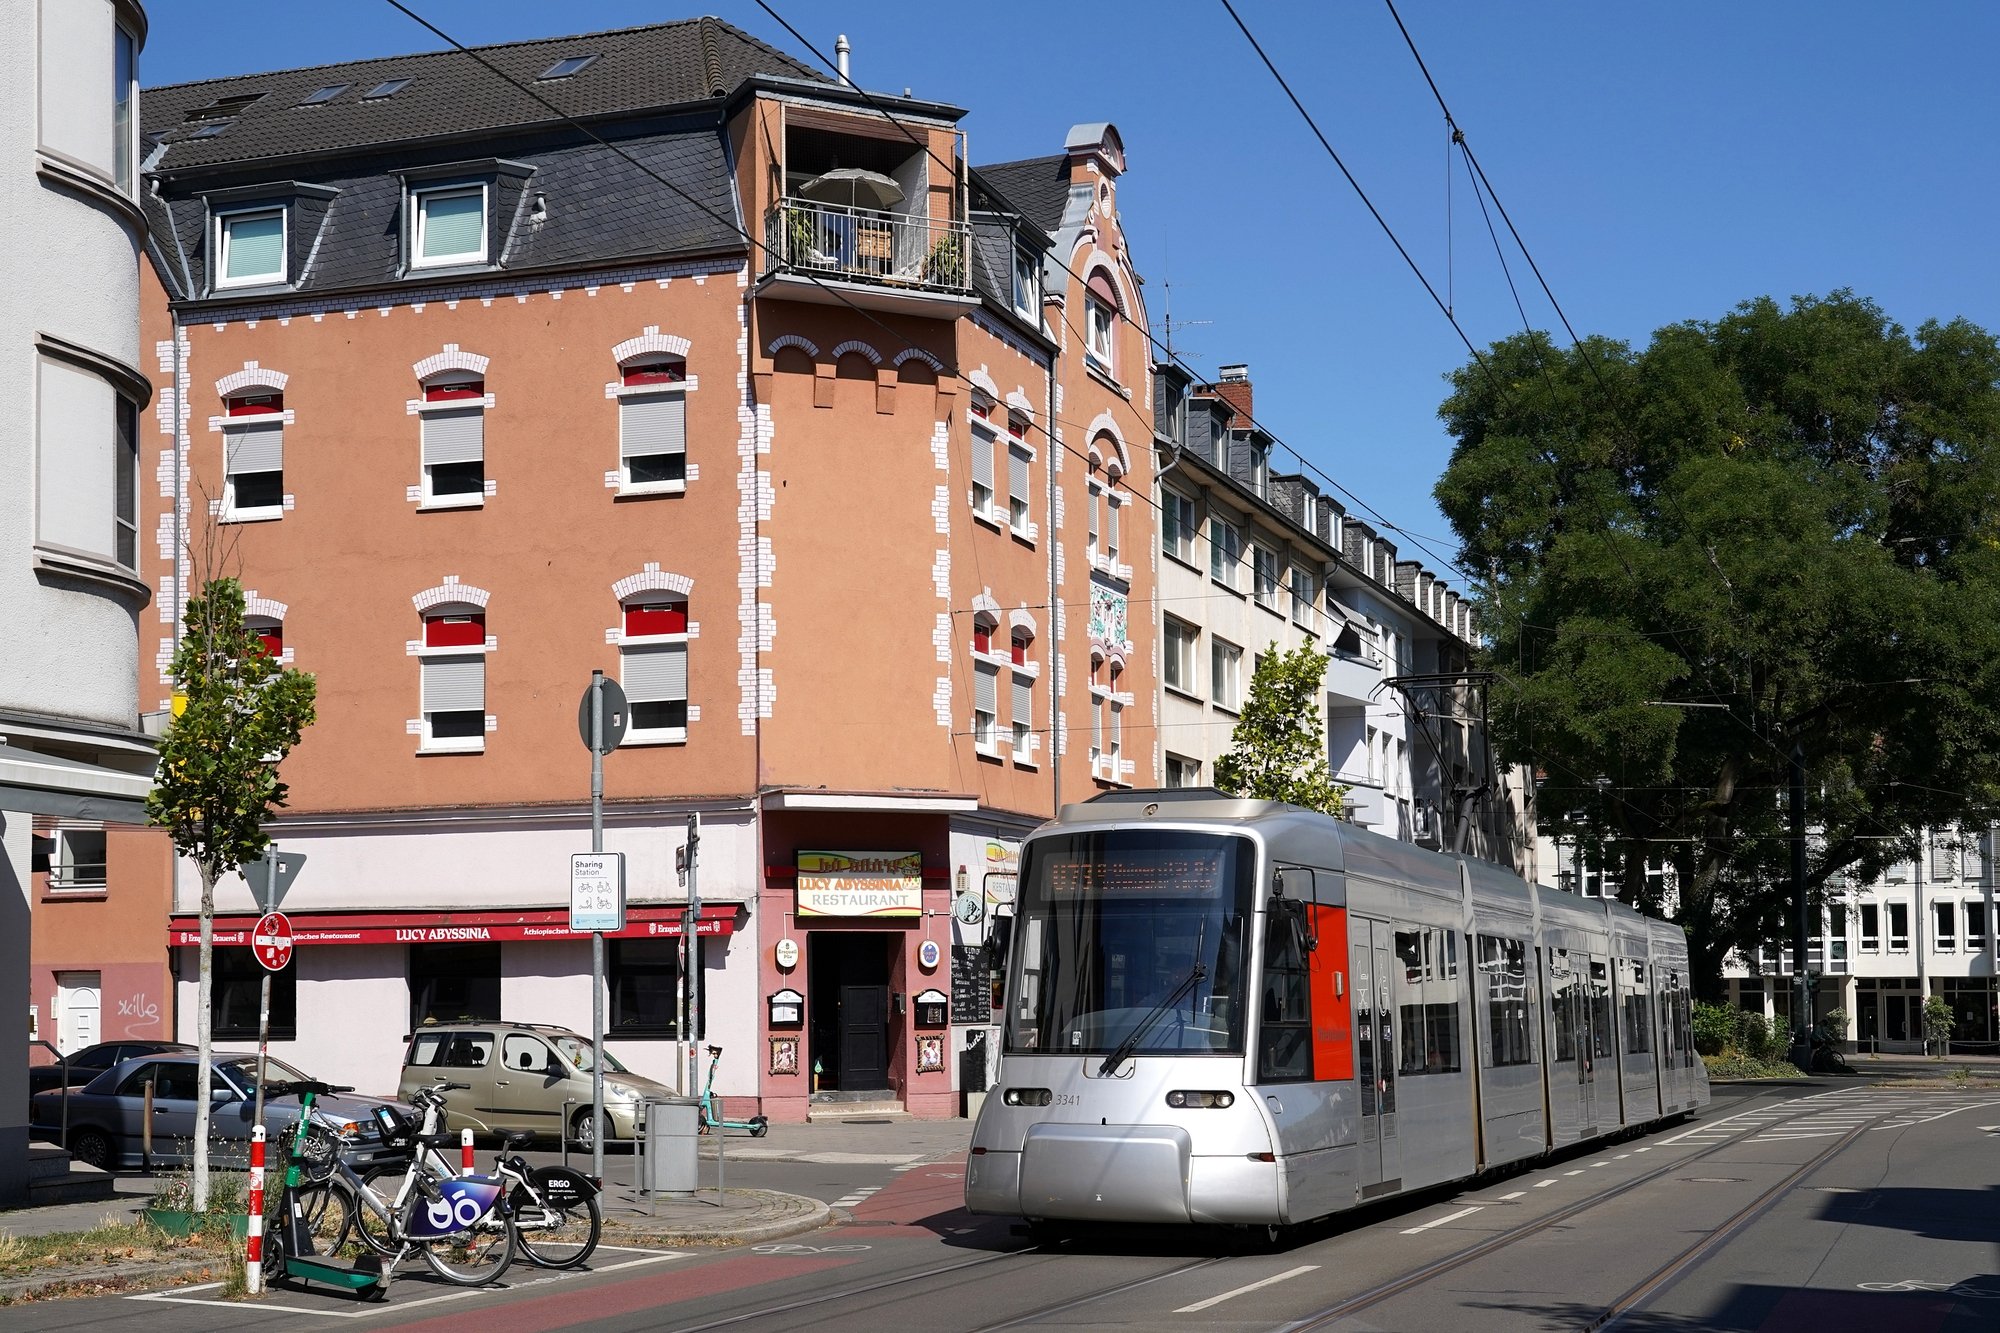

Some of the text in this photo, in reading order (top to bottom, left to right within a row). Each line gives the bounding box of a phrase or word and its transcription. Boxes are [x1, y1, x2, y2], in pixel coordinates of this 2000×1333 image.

[575, 861, 603, 869] Sharing
[799, 878, 903, 891] LUCY ABYSSINIA
[812, 894, 909, 906] RESTAURANT
[320, 932, 361, 940] Restaurant
[396, 927, 490, 941] LUCY ABYSSINIA
[523, 927, 569, 936] Äthiopisches
[212, 934, 237, 942] Brauerei
[966, 1031, 985, 1050] turbo
[1056, 1095, 1080, 1106] 3341
[548, 1180, 570, 1188] ERGO
